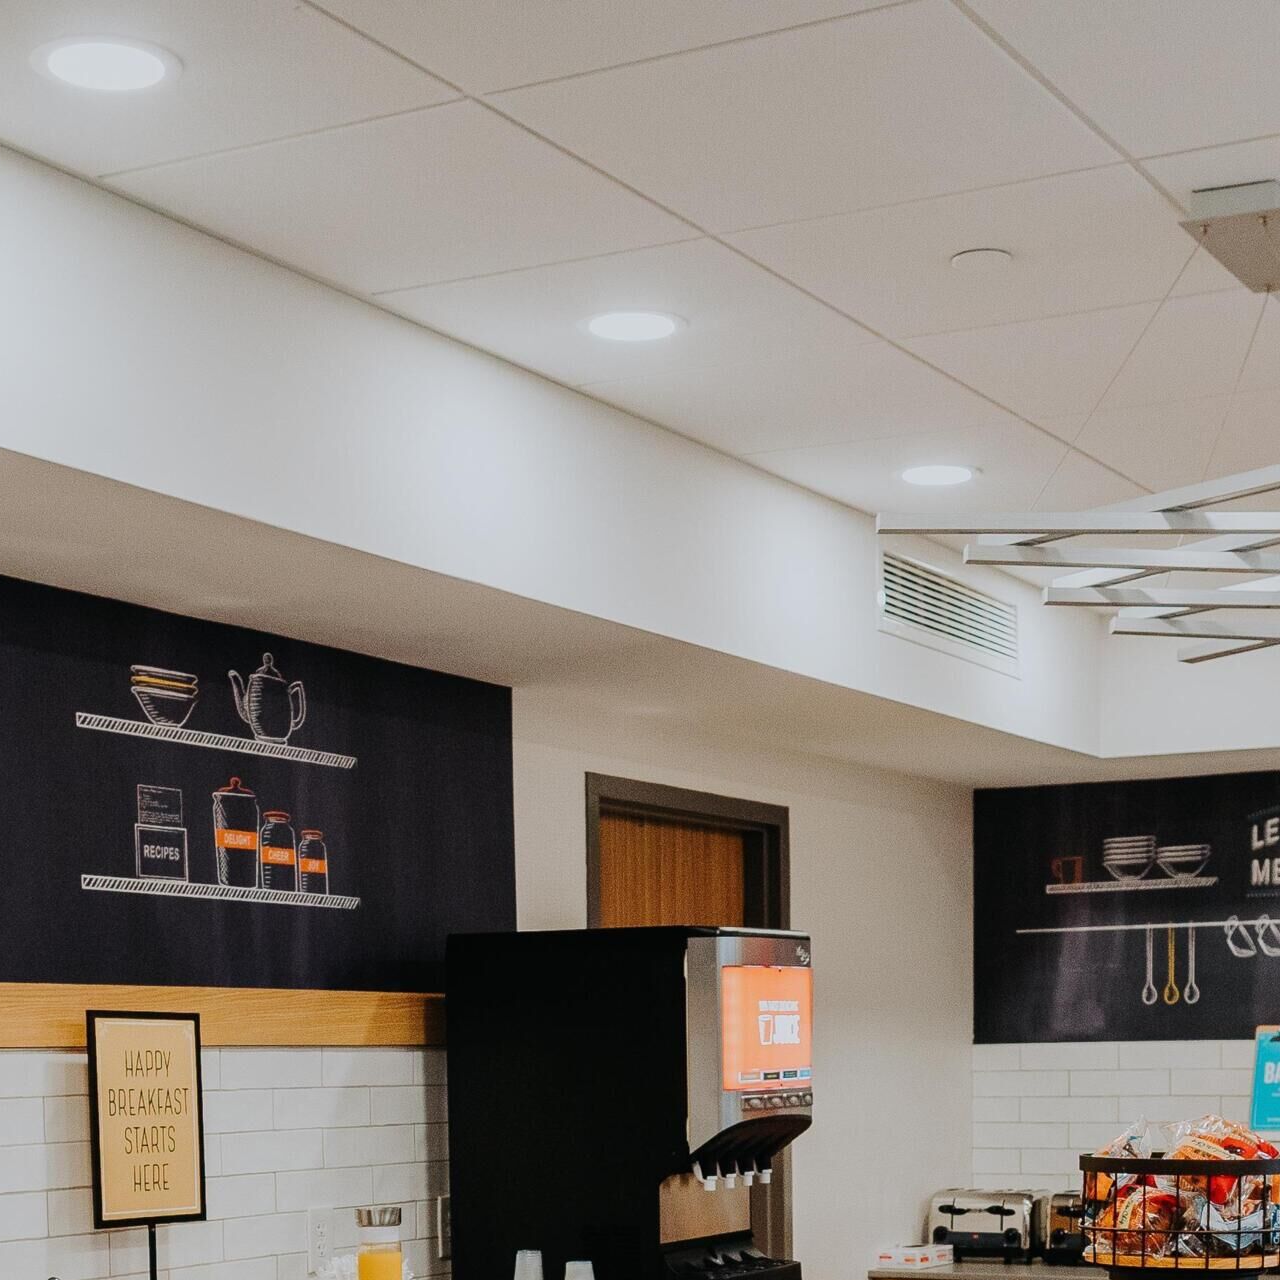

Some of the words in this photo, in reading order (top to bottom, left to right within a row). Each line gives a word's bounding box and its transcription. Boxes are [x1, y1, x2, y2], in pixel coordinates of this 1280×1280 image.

[143, 844, 180, 861] RECIPES
[224, 832, 252, 846] DELIGHT
[124, 1050, 171, 1078] HAPPY
[108, 1087, 189, 1117] BREAKFAST
[124, 1125, 176, 1155] STARTS
[133, 1163, 170, 1193] HERE
